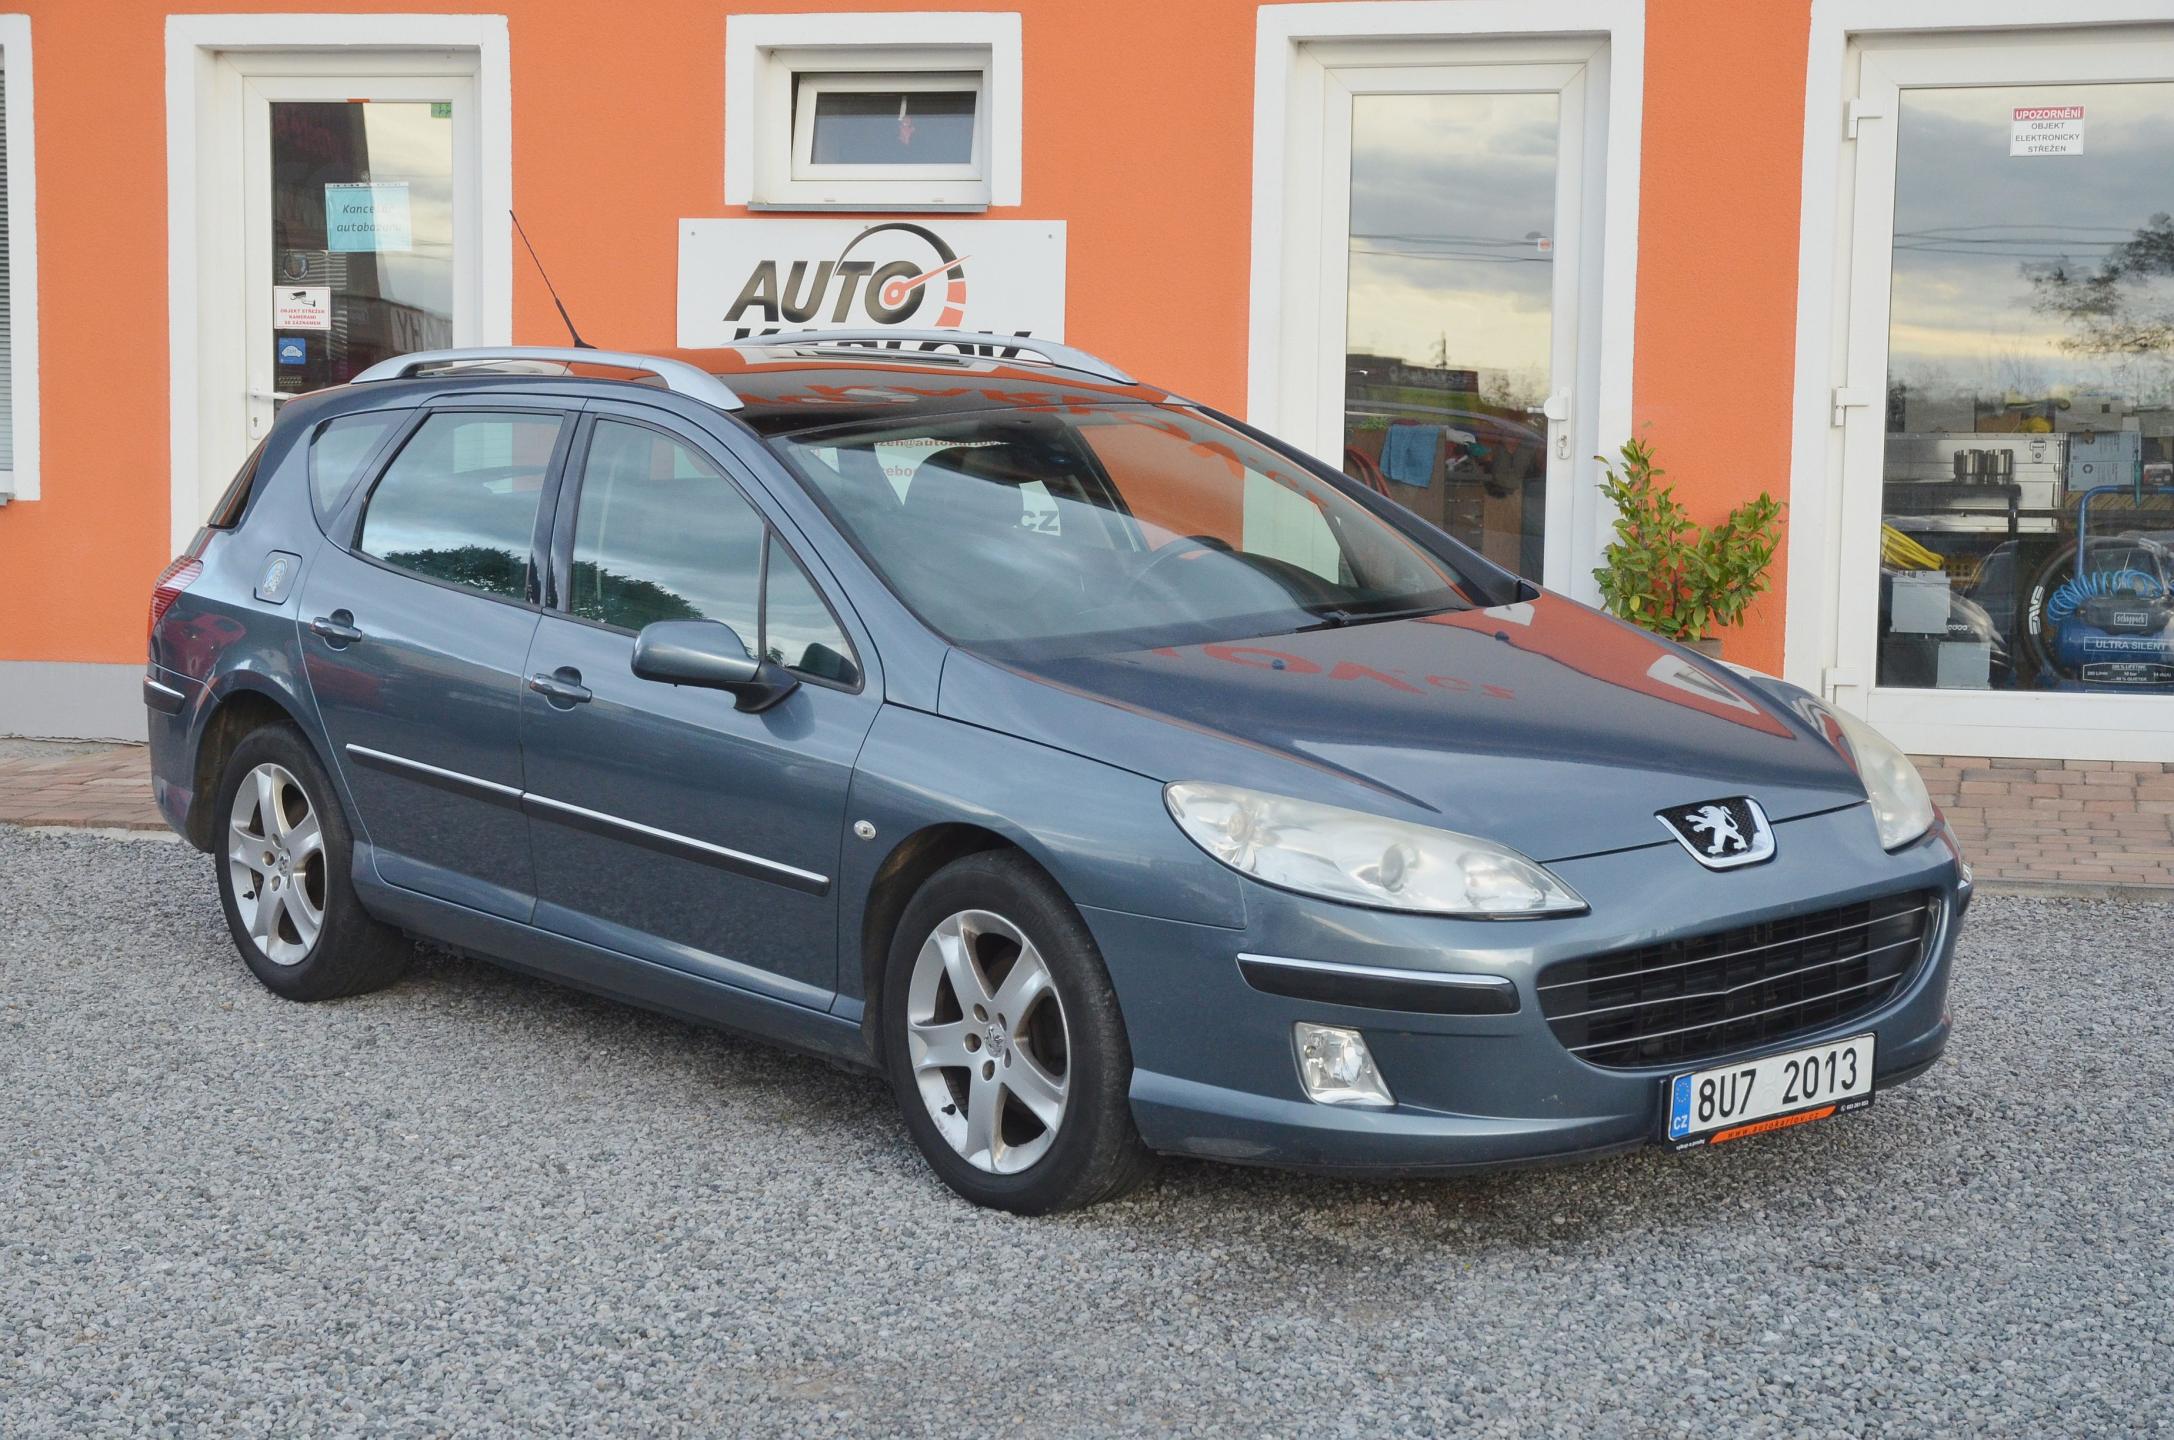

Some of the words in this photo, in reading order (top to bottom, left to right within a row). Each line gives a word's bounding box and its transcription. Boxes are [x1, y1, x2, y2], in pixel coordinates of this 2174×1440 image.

[2015, 107, 2081, 119] UPOZORNĚNÍ
[2031, 122, 2065, 130] OBJEKT
[2015, 133, 2080, 142] ELEKTRONICKY
[723, 260, 926, 325] AUTO
[2095, 640, 2129, 649] ULTRA
[2131, 641, 2166, 651] SILENT
[1698, 1068, 1757, 1122] 8U7
[1782, 1047, 1858, 1105] 2013
[1673, 1115, 1688, 1130] CZ
